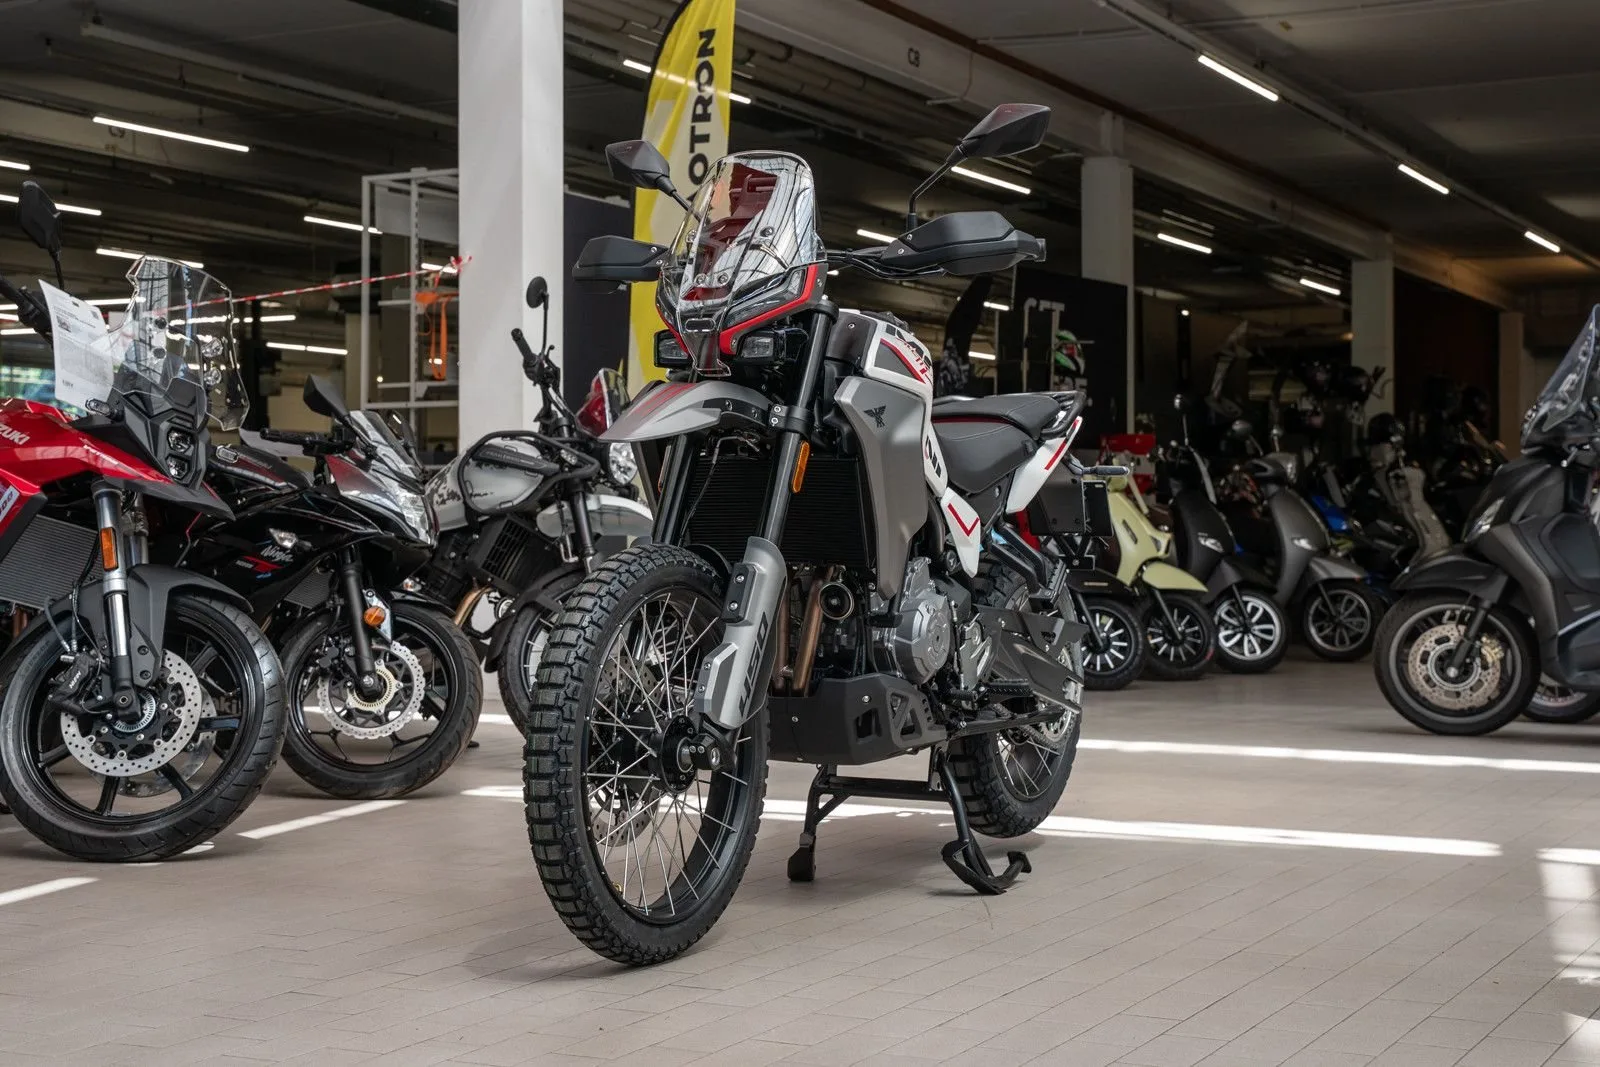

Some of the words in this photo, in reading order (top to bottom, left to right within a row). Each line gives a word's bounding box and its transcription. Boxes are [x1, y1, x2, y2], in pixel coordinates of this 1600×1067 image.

[687, 28, 716, 202] OTRON
[260, 544, 294, 562] Ninja
[739, 611, 768, 718] 450
